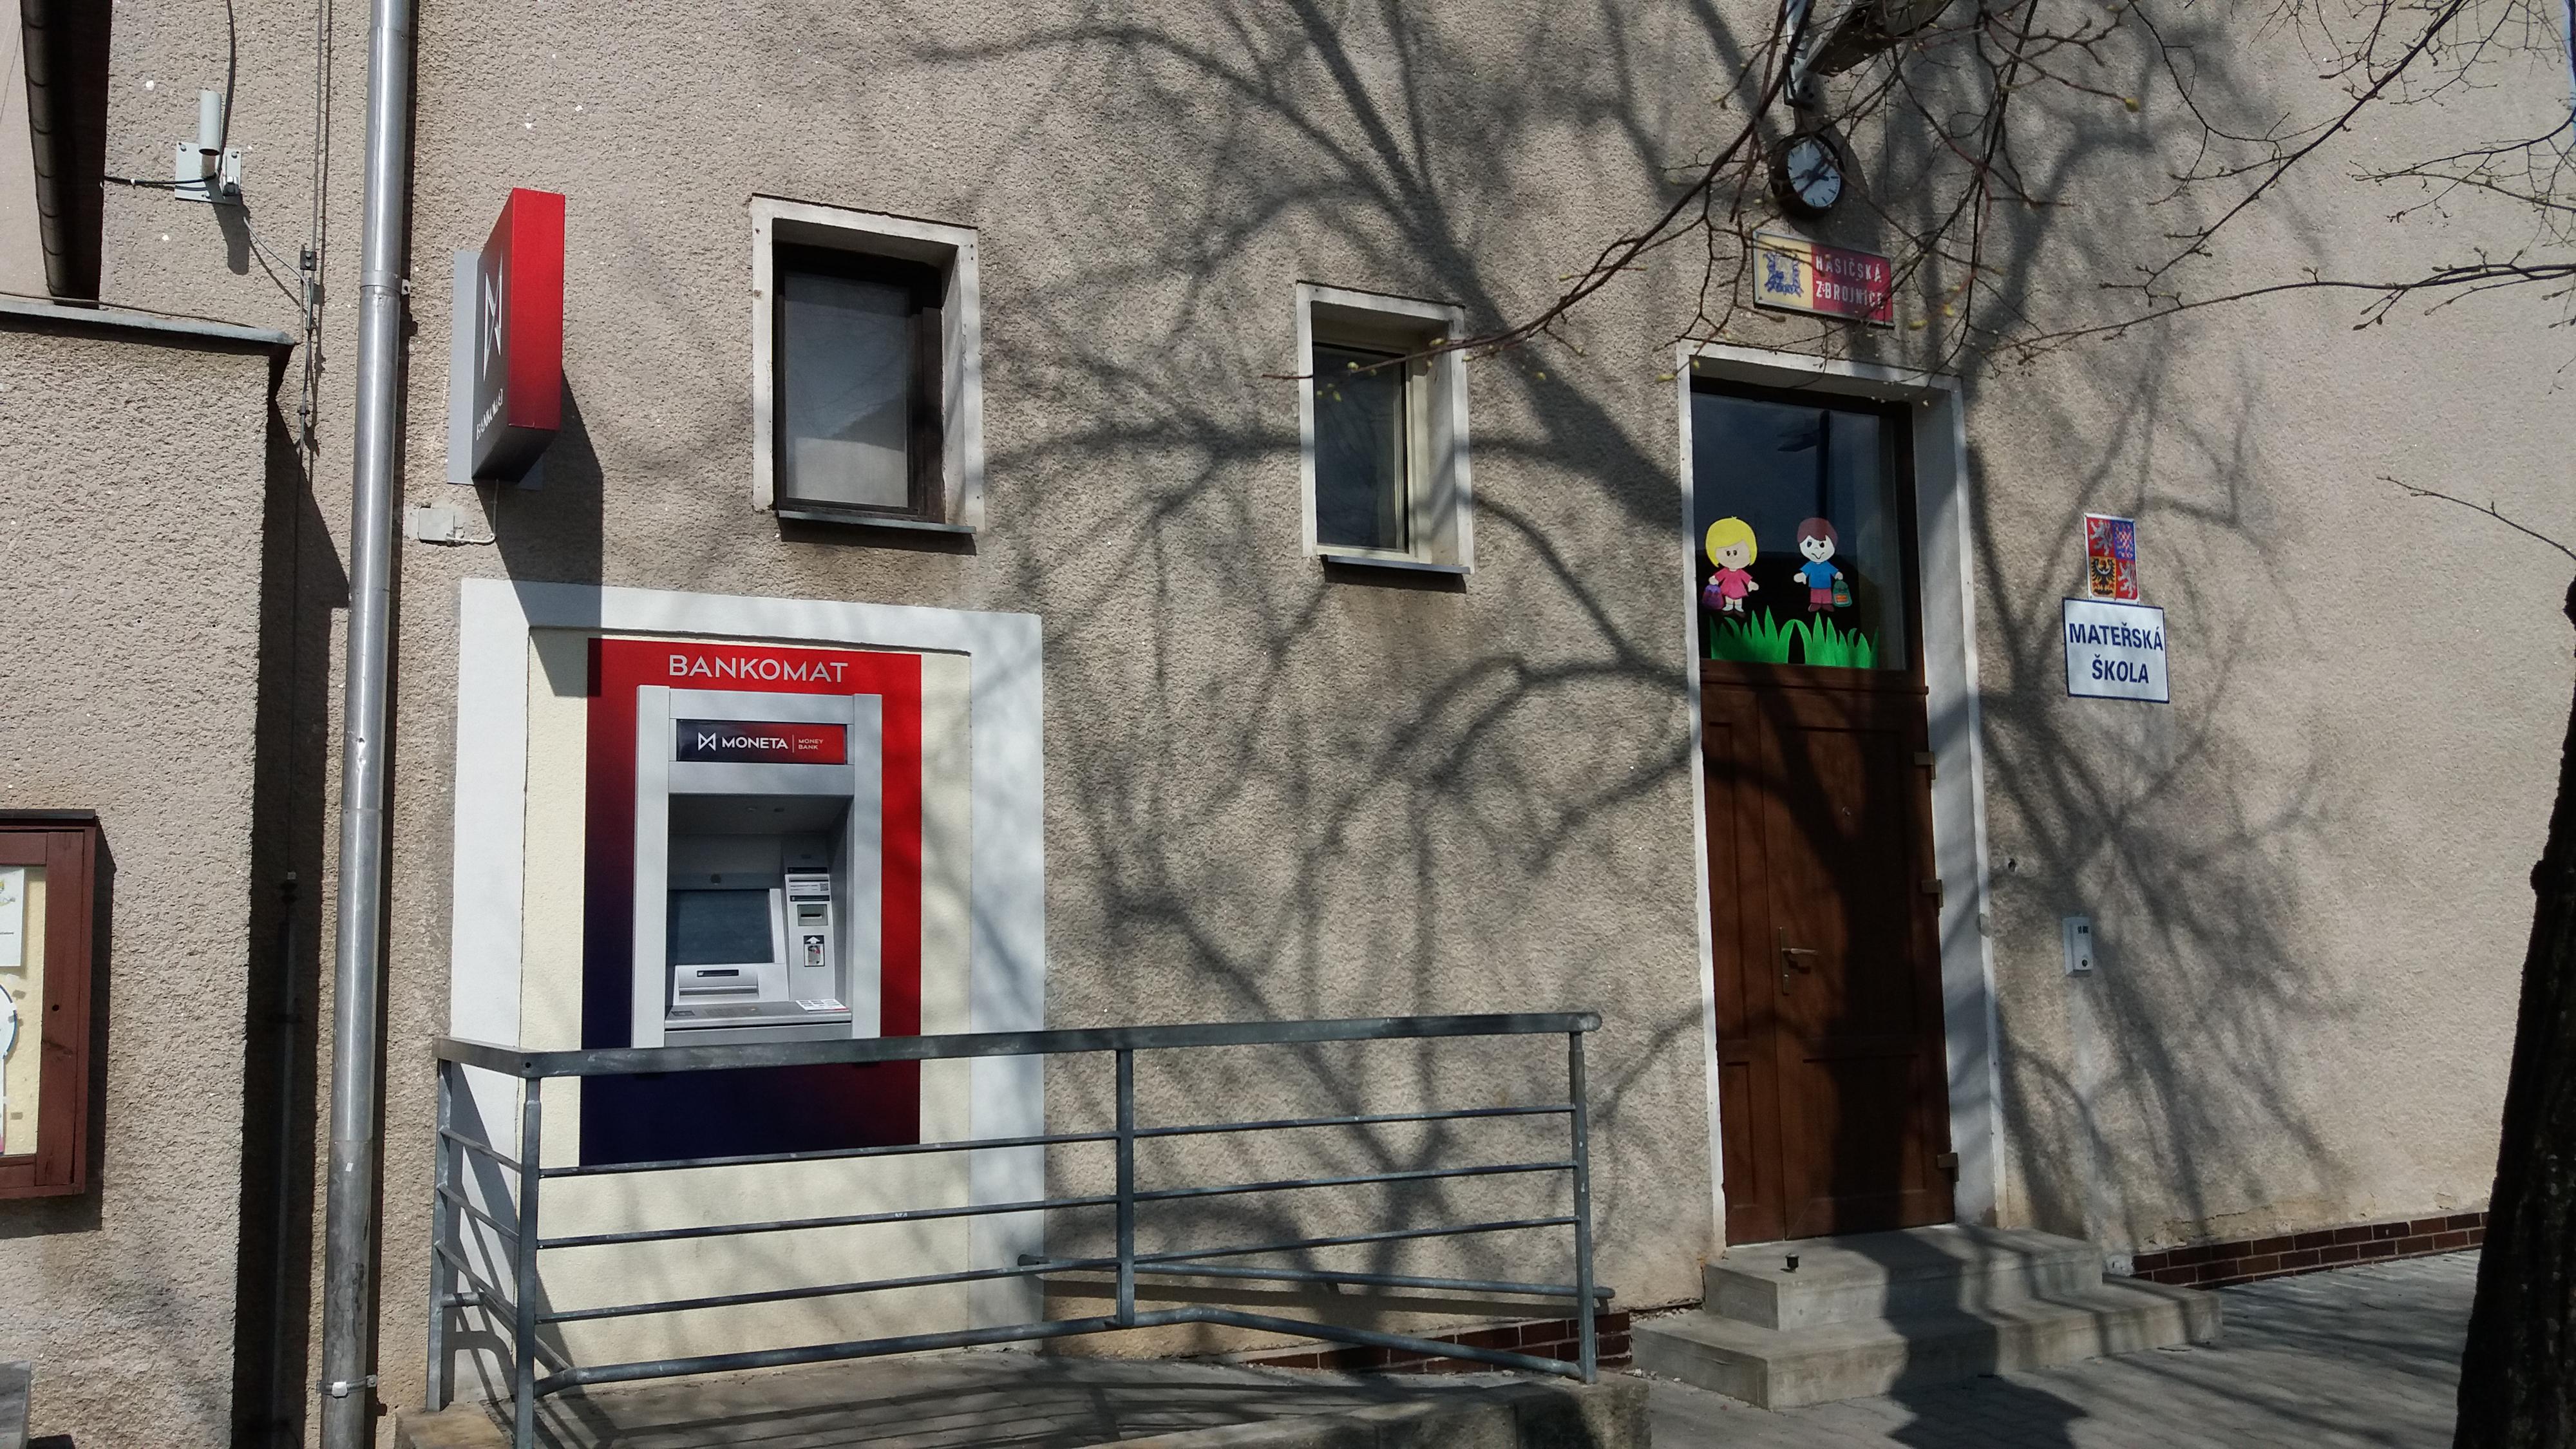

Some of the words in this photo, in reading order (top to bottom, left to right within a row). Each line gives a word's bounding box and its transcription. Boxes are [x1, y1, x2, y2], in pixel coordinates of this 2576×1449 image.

[2069, 622, 2164, 651] MATEŘSKÁ
[669, 654, 849, 683] BANKOMAT
[2091, 654, 2149, 684] ŠKOLA
[721, 736, 789, 750] MONETA
